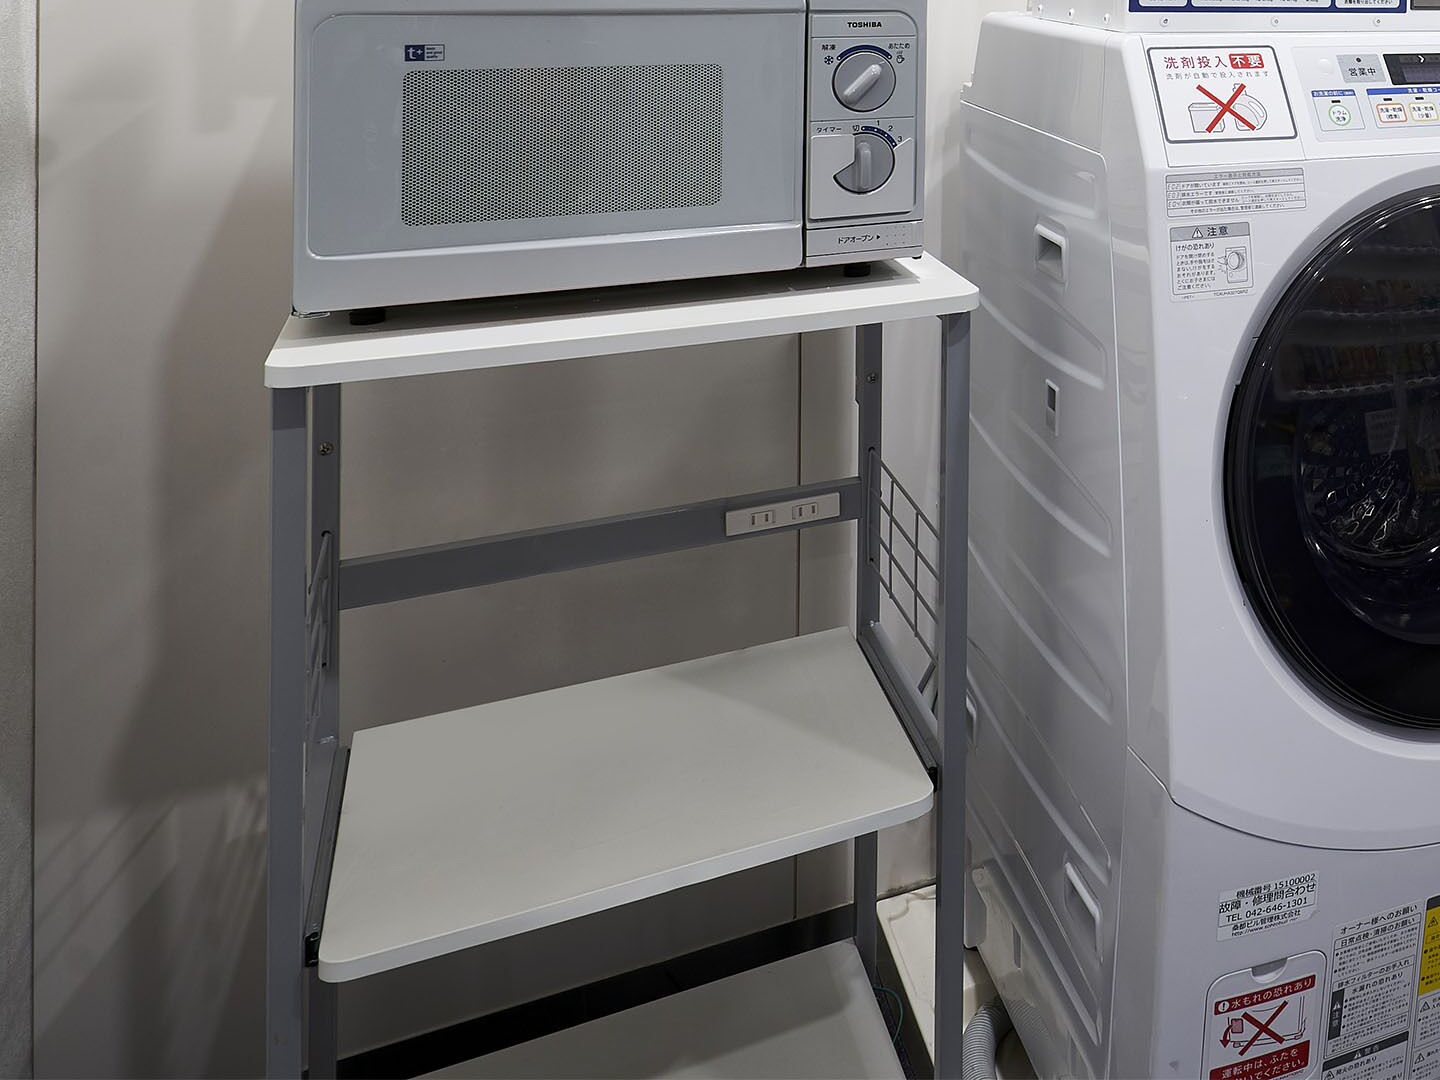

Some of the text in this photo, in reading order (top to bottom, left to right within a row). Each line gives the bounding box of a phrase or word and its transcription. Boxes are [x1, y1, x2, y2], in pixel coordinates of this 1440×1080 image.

[1164, 55, 1263, 69] 洗剤投入 不要
[1349, 67, 1376, 76] 営業中
[1207, 226, 1228, 236] 注意
[838, 235, 873, 244] ドアオープン
[1176, 243, 1215, 252] けがの恐れあり
[1236, 873, 1315, 899] 機械番号 15100002
[1226, 897, 1307, 922] TEL 042-646-1301
[1340, 905, 1417, 934] オーナー様へのお願い
[1232, 979, 1311, 1008] 水もれの恐れあり
